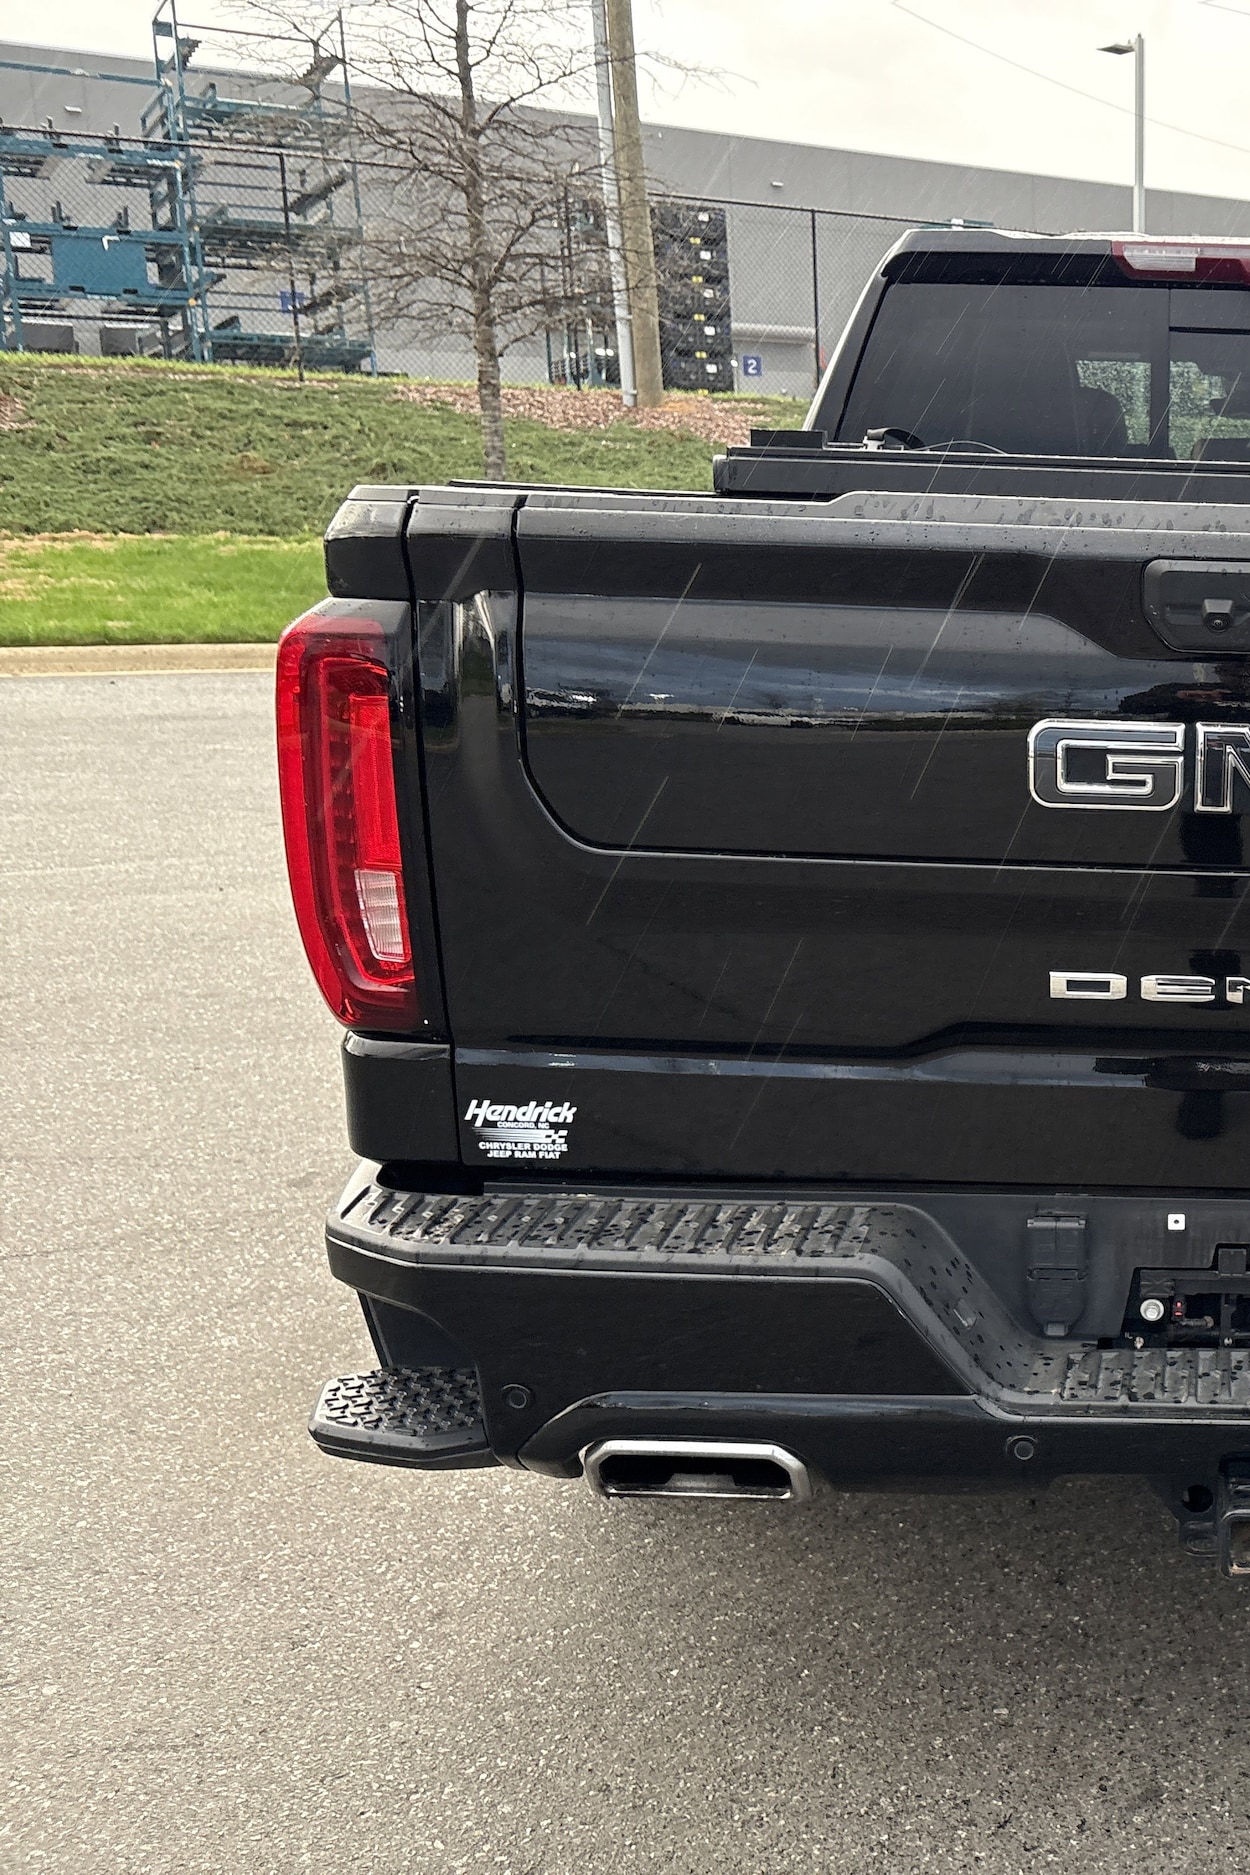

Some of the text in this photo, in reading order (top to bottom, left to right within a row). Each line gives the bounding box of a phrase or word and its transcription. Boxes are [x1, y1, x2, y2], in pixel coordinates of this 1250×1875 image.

[747, 358, 757, 373] 2
[464, 1099, 577, 1127] Hendrick
[478, 1141, 568, 1151] CHRYSLER DODGE
